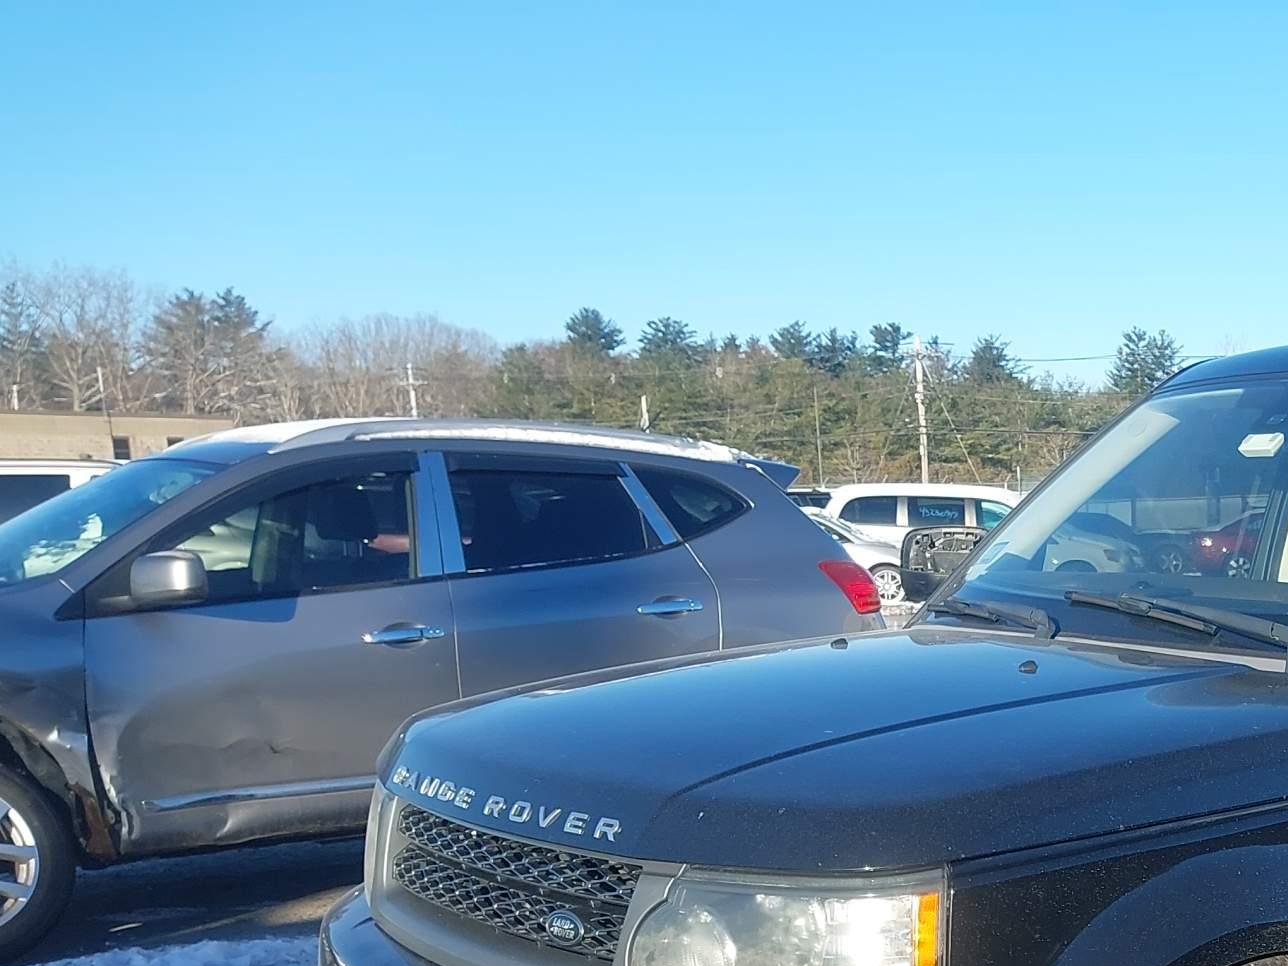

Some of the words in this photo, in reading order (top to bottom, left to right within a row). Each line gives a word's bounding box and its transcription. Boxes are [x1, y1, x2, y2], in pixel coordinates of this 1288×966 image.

[392, 766, 476, 809] RANGE
[483, 795, 623, 842] ROVER
[551, 926, 575, 940] ROVER
